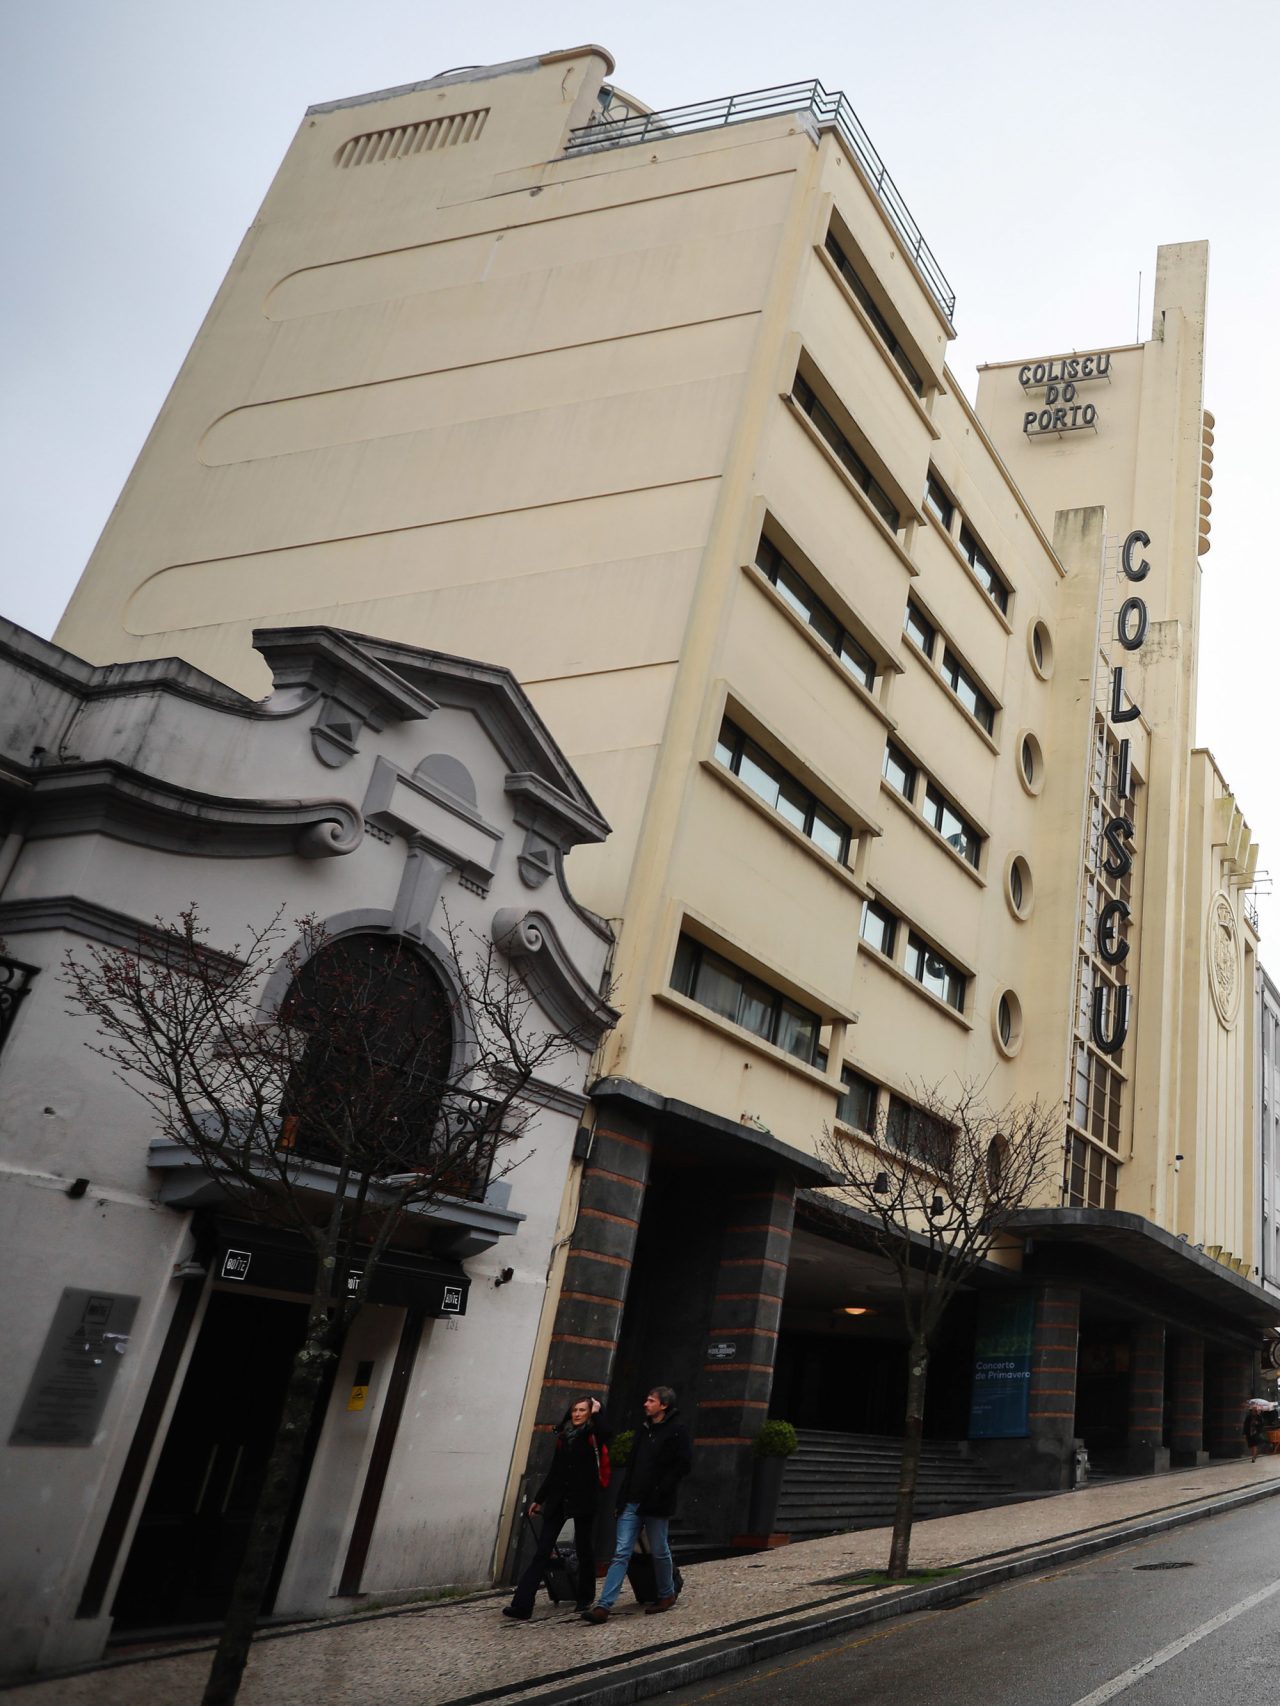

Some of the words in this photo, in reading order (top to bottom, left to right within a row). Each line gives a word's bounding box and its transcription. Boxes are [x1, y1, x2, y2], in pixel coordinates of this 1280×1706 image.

[1018, 353, 1110, 386] COLISEU
[1045, 382, 1076, 405] DO
[1023, 403, 1096, 433] PORTO
[1093, 530, 1150, 1054] COLISEU
[976, 1361, 1015, 1370] Concerto
[976, 1372, 986, 1380] de
